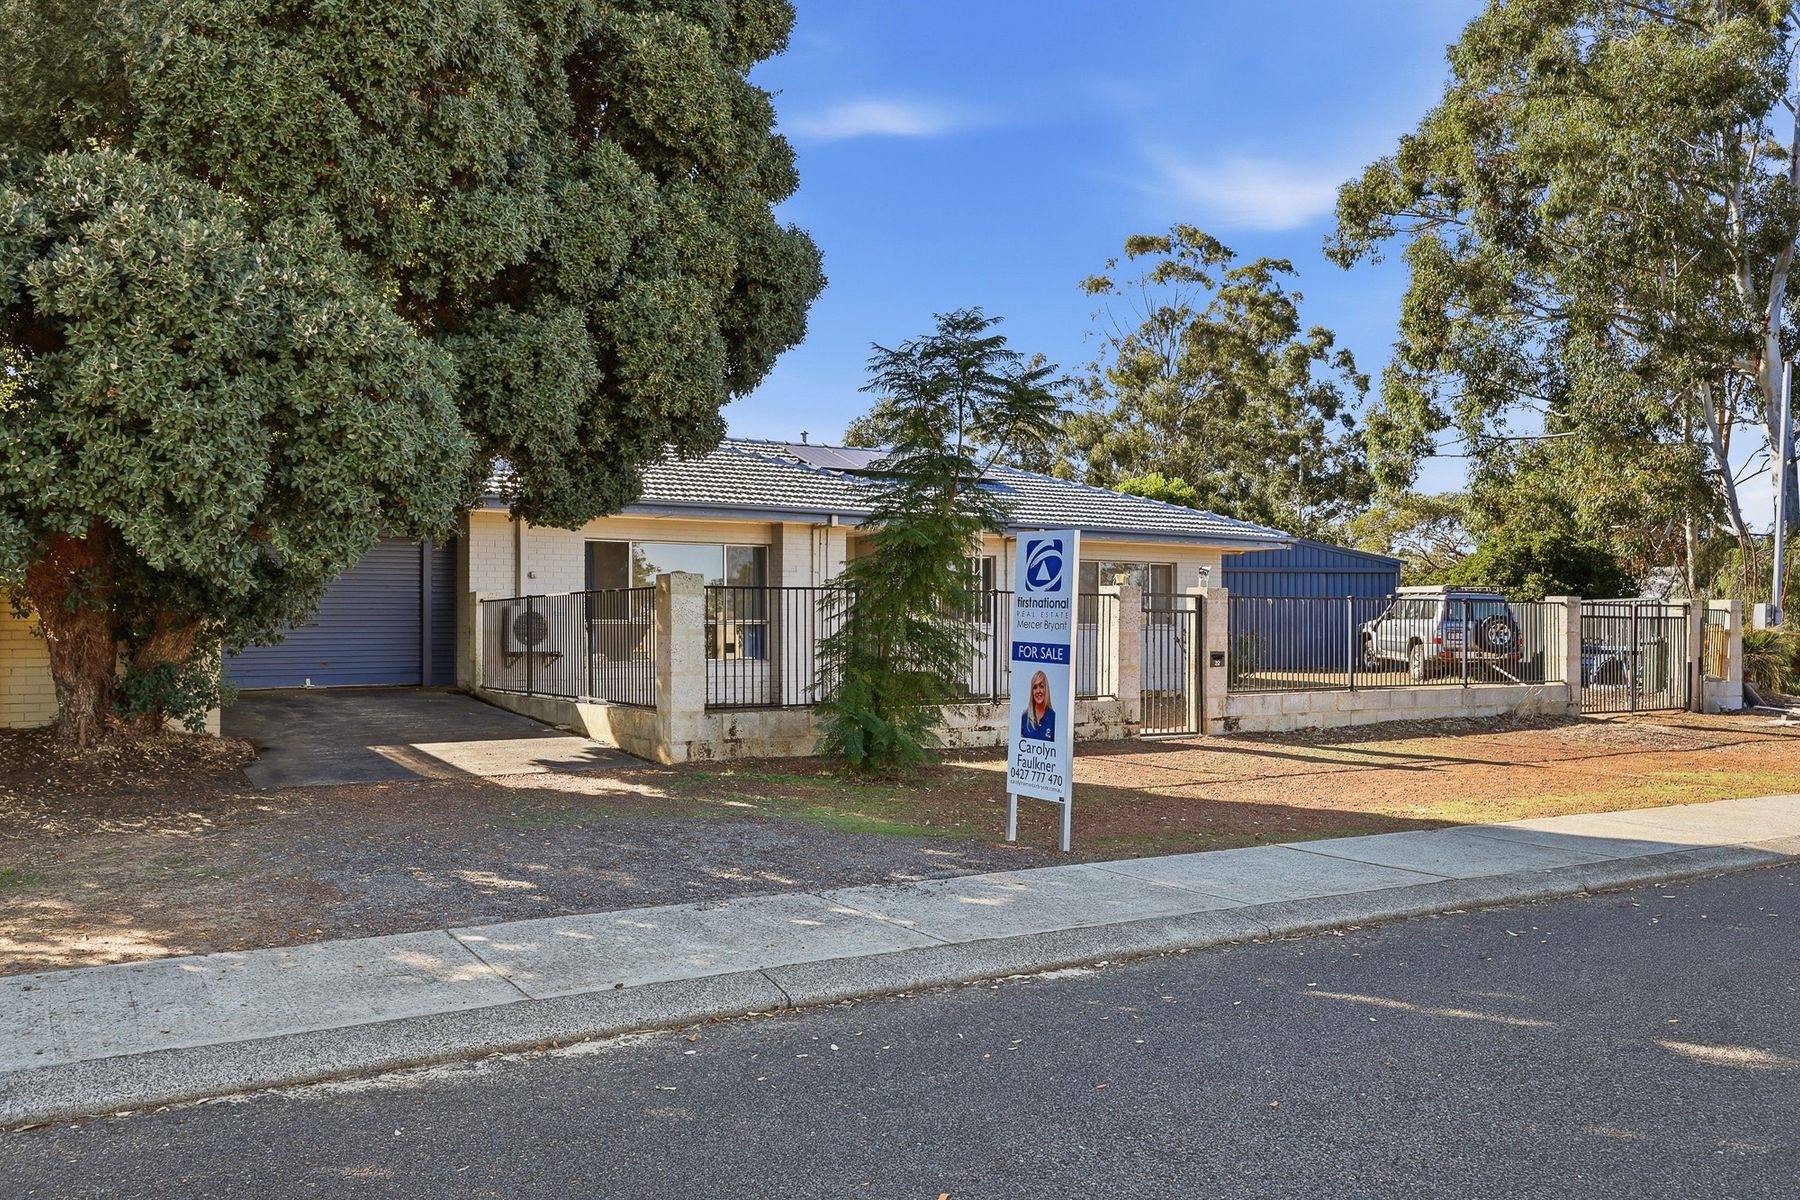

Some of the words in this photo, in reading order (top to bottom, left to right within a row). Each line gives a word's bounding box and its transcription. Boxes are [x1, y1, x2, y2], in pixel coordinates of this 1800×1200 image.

[1017, 620, 1042, 630] Mercer
[1044, 621, 1068, 632] Bryant
[1018, 646, 1038, 659] FOR
[1040, 647, 1064, 661] SALE
[1018, 739, 1057, 760] Carolyn
[1017, 754, 1056, 772] Faulkner
[1010, 767, 1030, 780] 0427
[1031, 770, 1046, 783] 777
[1048, 774, 1063, 787] 470
